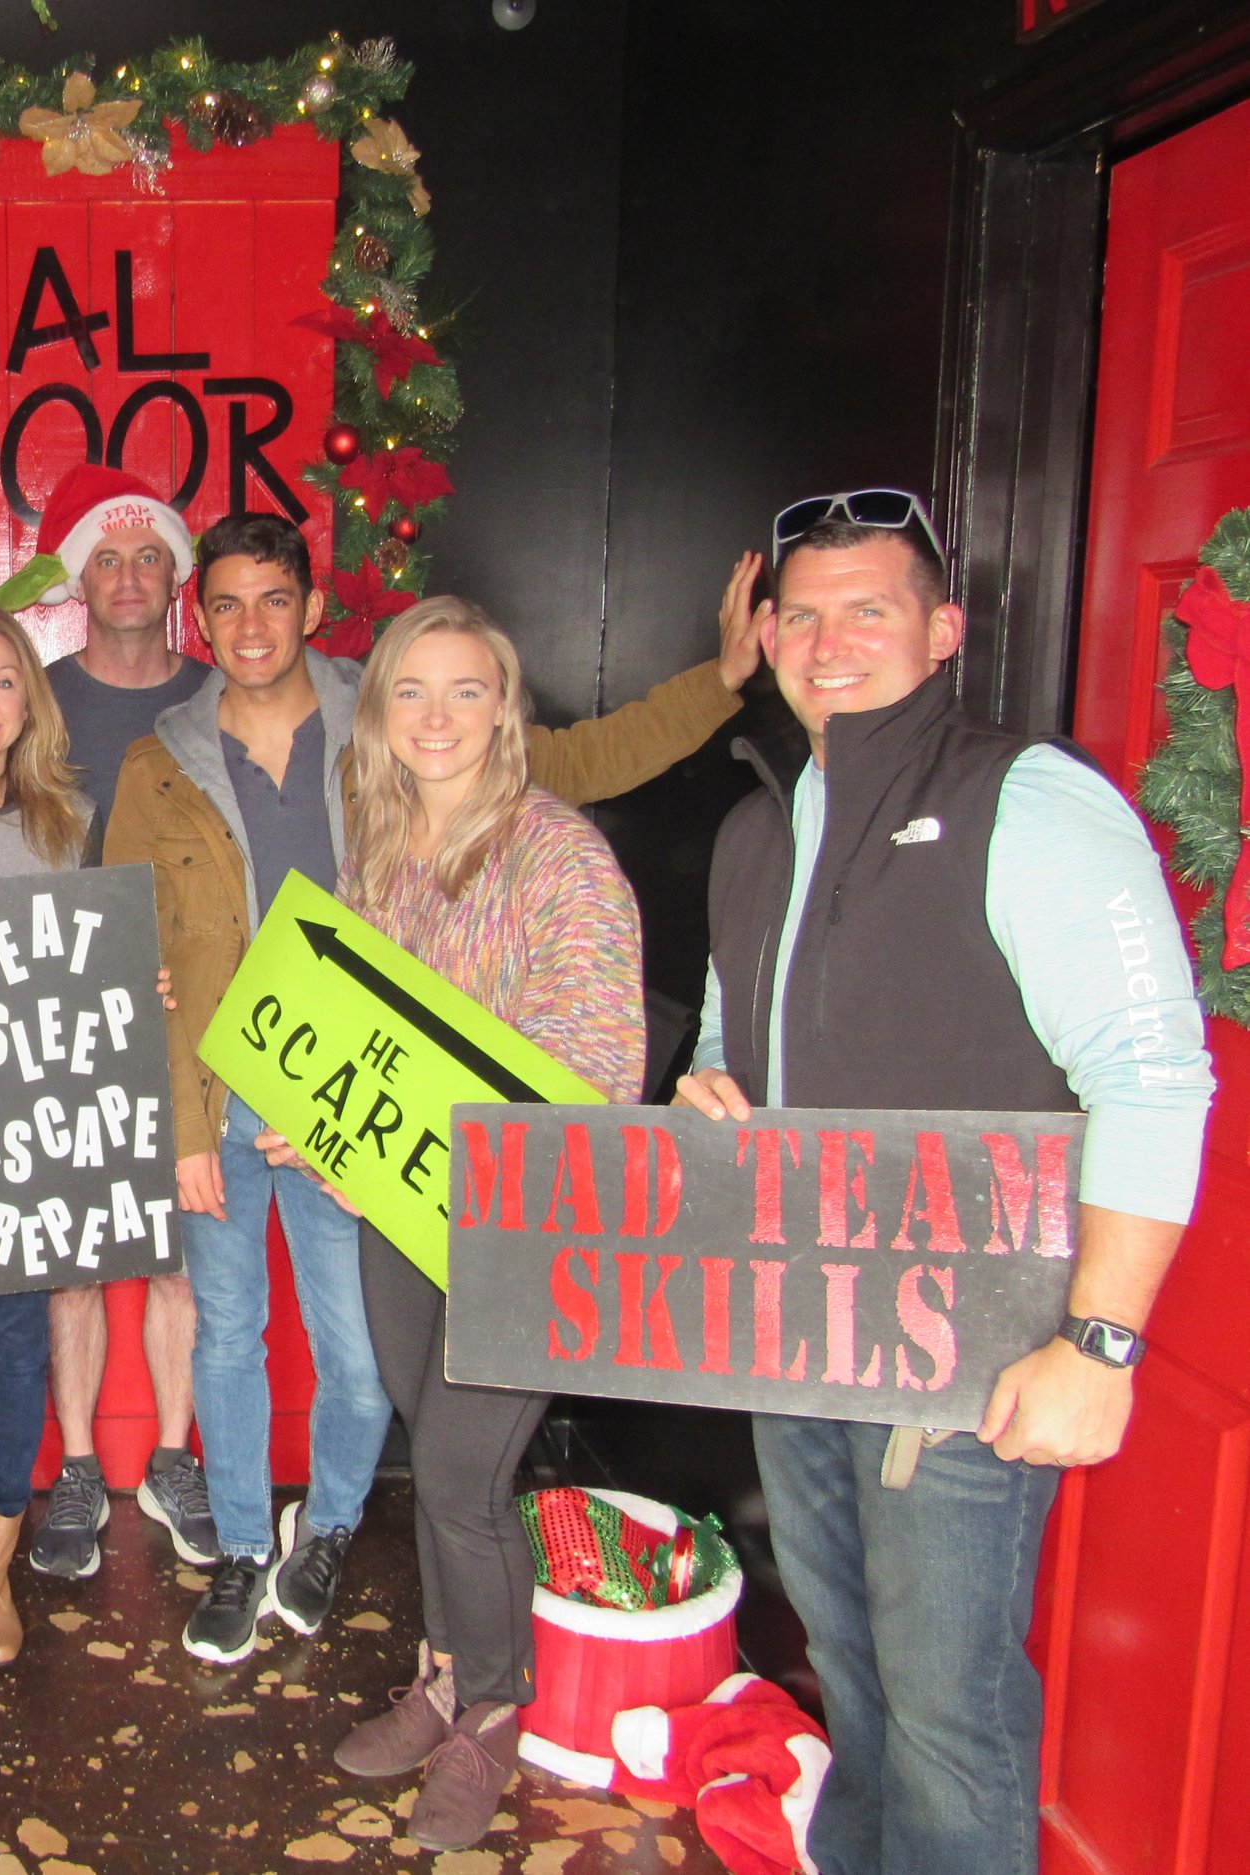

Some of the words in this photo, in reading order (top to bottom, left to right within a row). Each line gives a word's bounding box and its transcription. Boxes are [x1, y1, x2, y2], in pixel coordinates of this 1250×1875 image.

[240, 994, 449, 1222] SCARE
[360, 1028, 410, 1085] HE
[304, 1117, 358, 1181] ME
[457, 1121, 685, 1238] MAD
[736, 1127, 1072, 1259] TEAM
[548, 1246, 955, 1392] SKILLS
